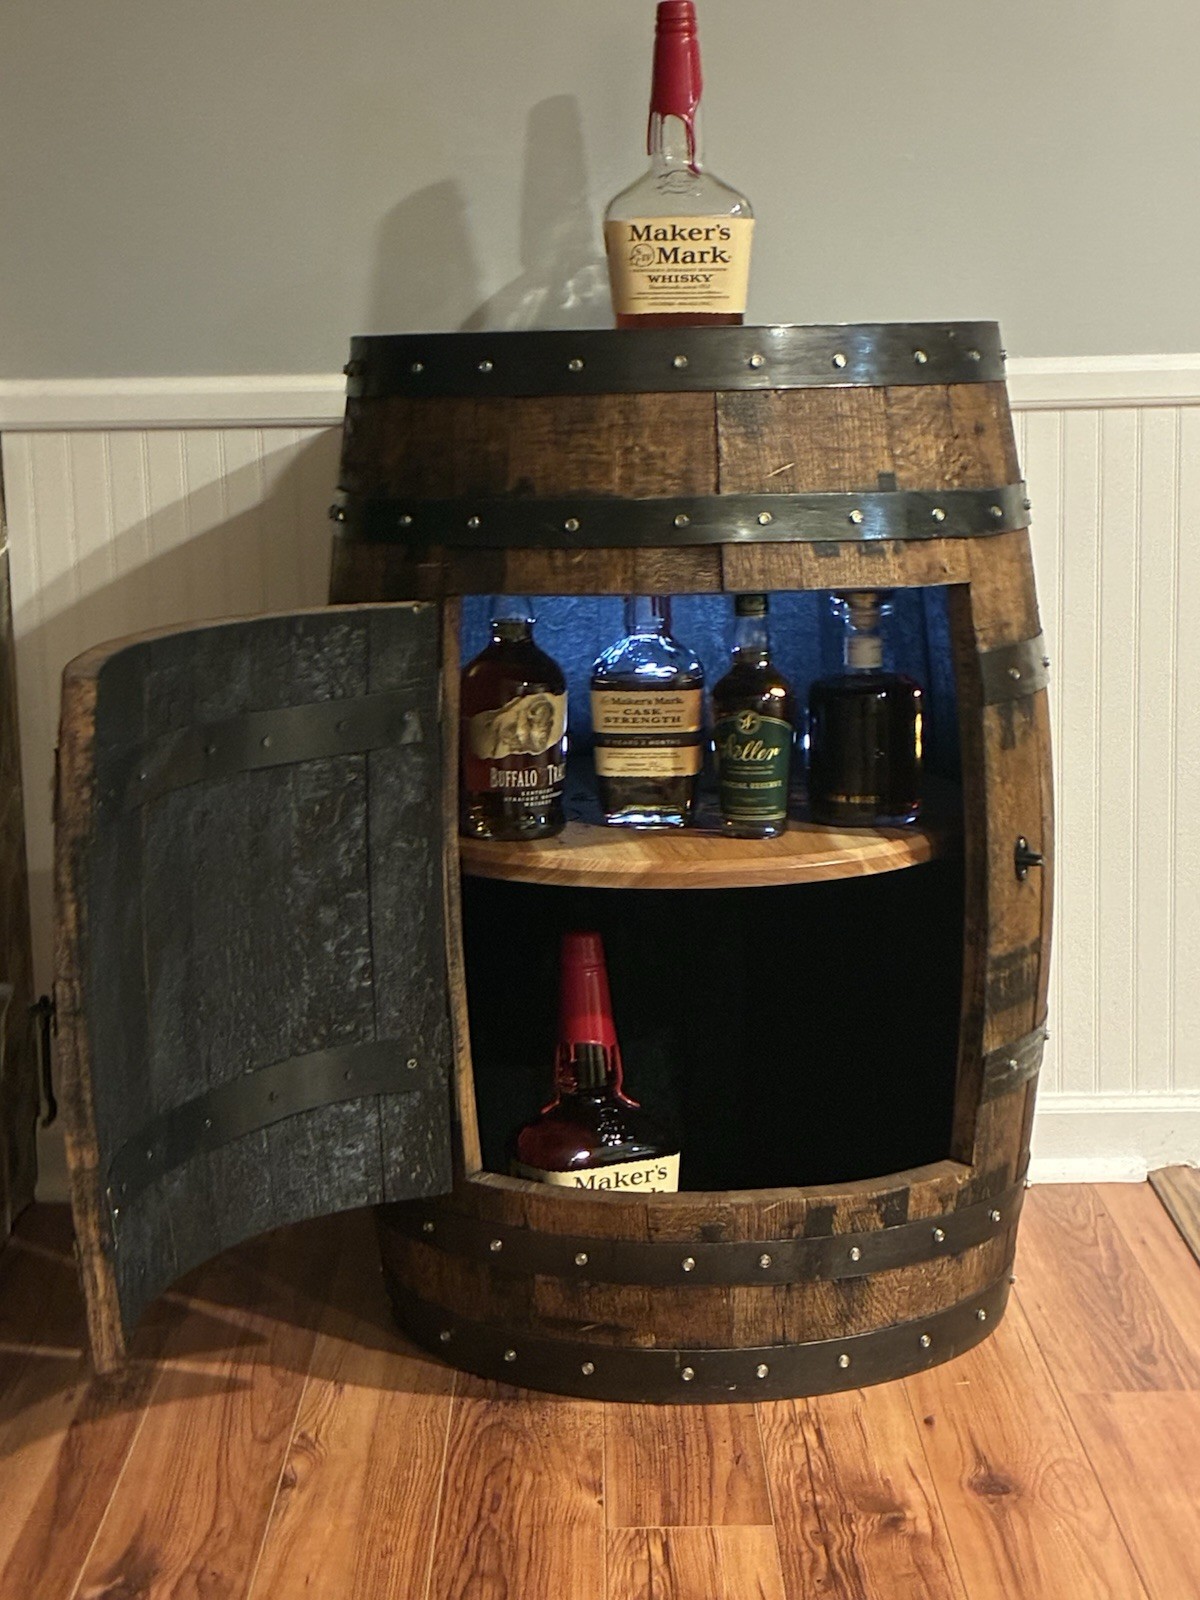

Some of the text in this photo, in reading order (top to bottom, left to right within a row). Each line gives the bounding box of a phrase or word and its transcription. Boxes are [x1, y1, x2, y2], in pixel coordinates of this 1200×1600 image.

[628, 224, 731, 242] Maker's
[656, 246, 730, 264] Mark
[647, 274, 713, 283] WHISKY
[490, 767, 538, 788] BUFFALO
[574, 1165, 668, 1189] Maker's
